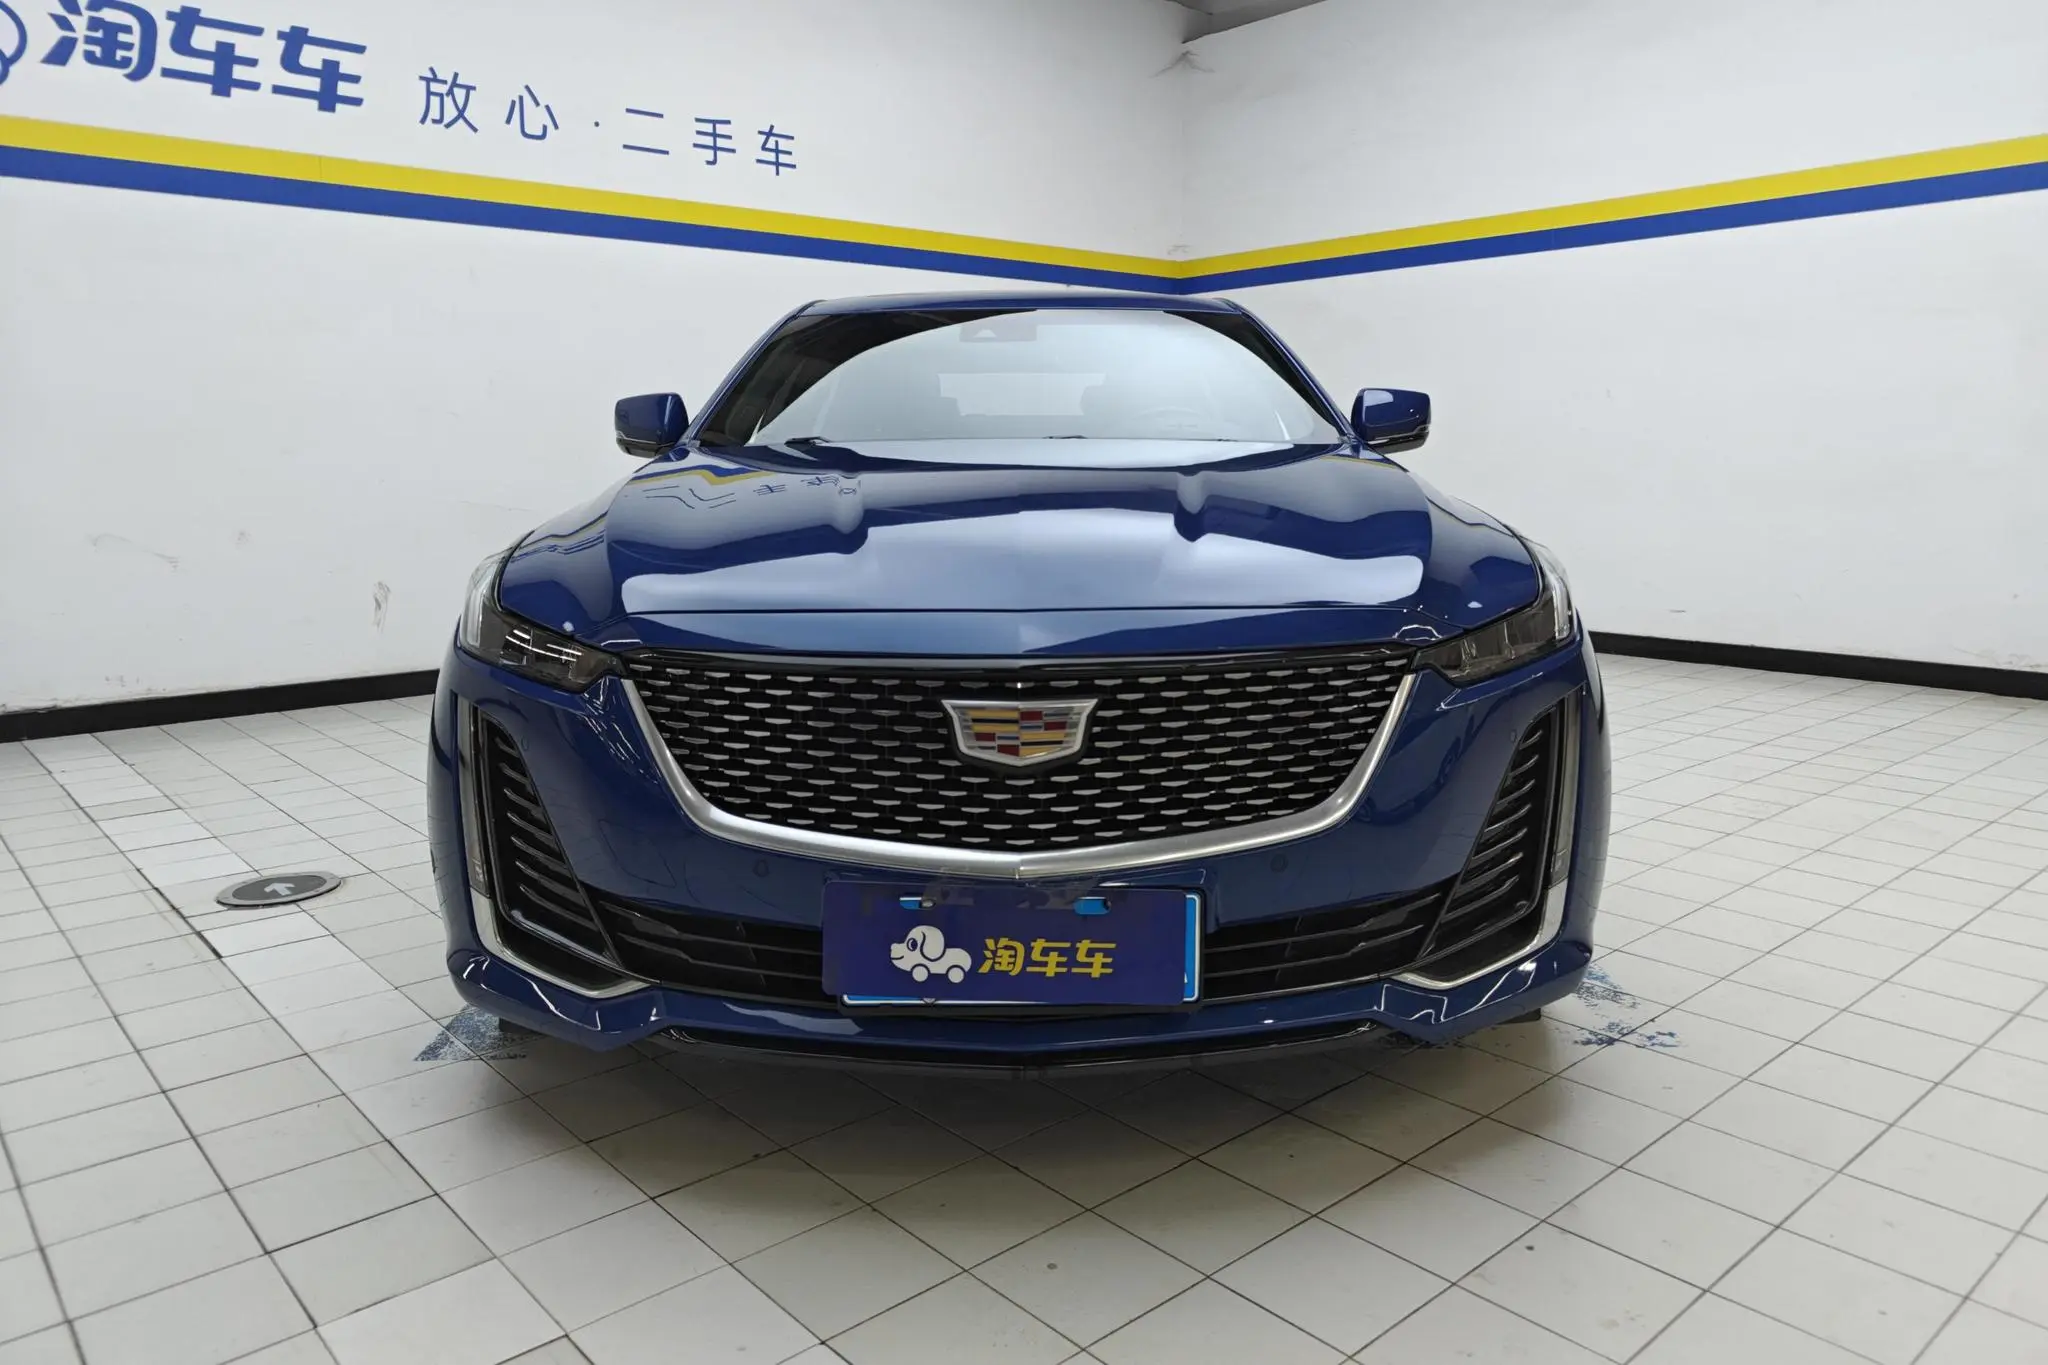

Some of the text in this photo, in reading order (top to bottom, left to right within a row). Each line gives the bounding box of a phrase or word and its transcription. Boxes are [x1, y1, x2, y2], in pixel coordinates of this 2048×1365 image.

[40, 0, 367, 113] 淘车车
[977, 937, 1117, 978] 淘车车
